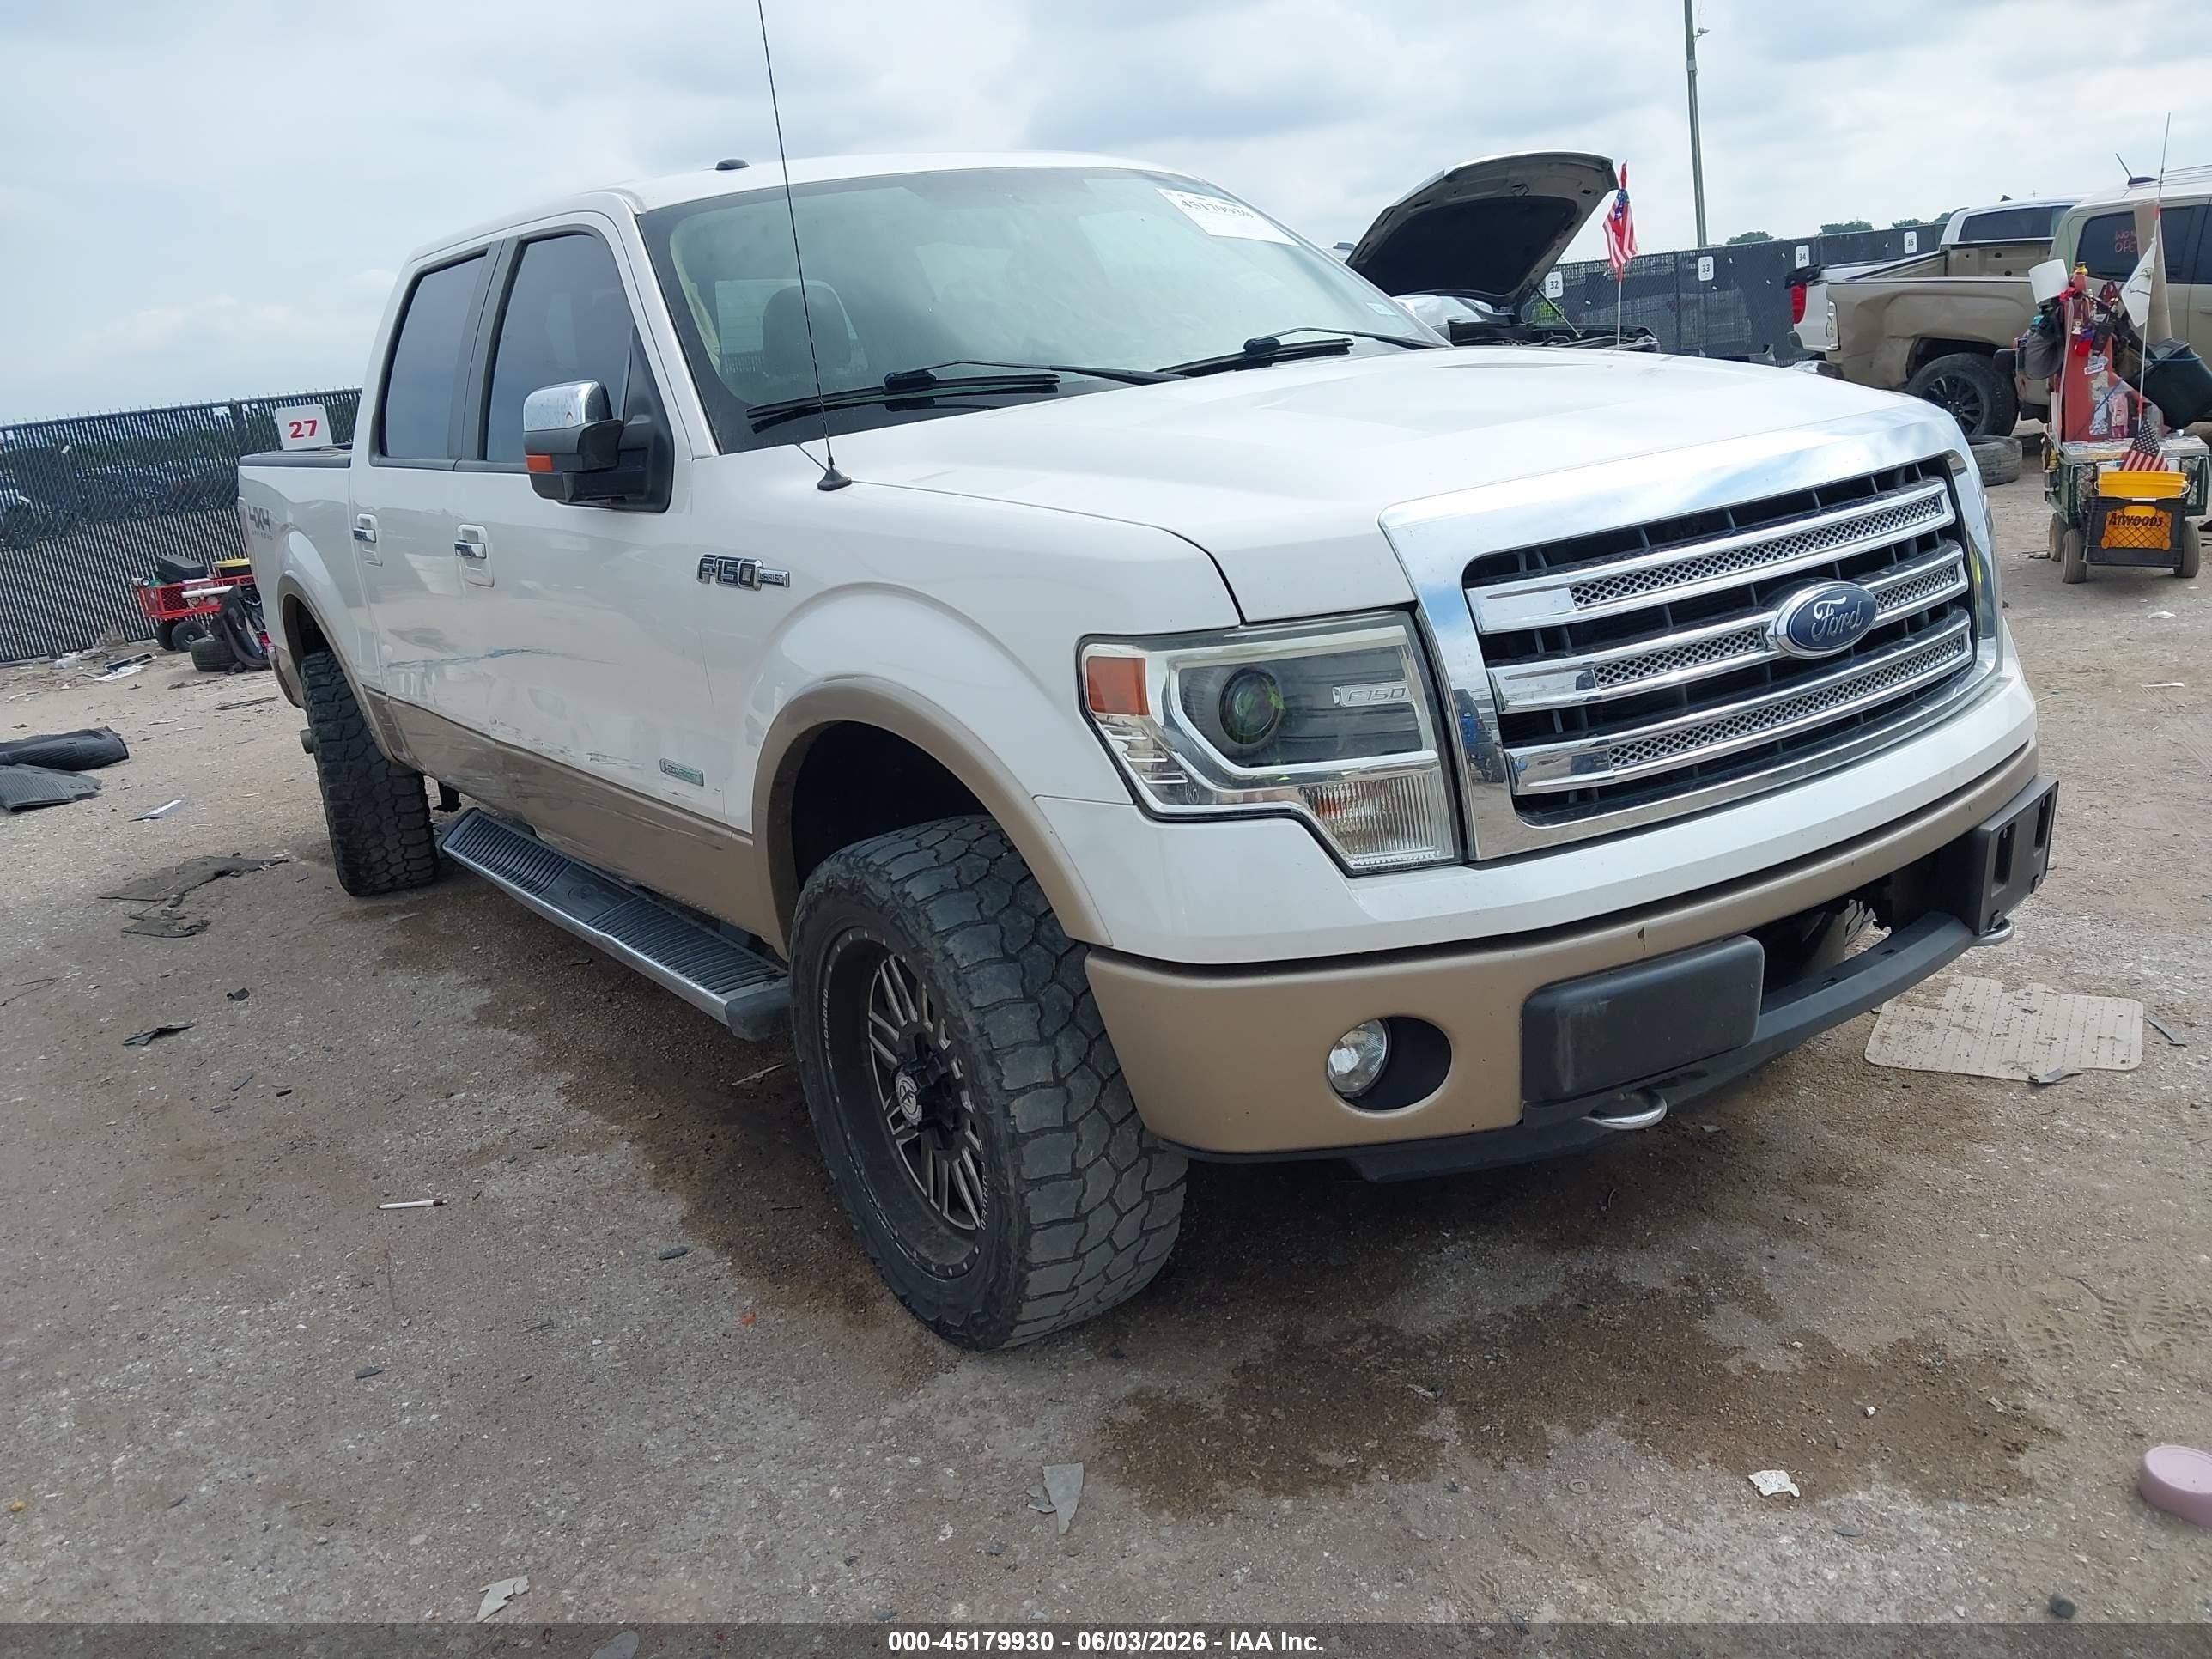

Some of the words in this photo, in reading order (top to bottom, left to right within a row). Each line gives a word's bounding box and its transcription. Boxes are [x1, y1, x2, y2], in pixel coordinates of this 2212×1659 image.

[1907, 238, 1915, 246] 35
[1798, 252, 1807, 262] 34
[1702, 264, 1711, 273] 33
[1549, 280, 1559, 289] 32
[288, 419, 318, 439] 27
[1811, 596, 1863, 642] Ford
